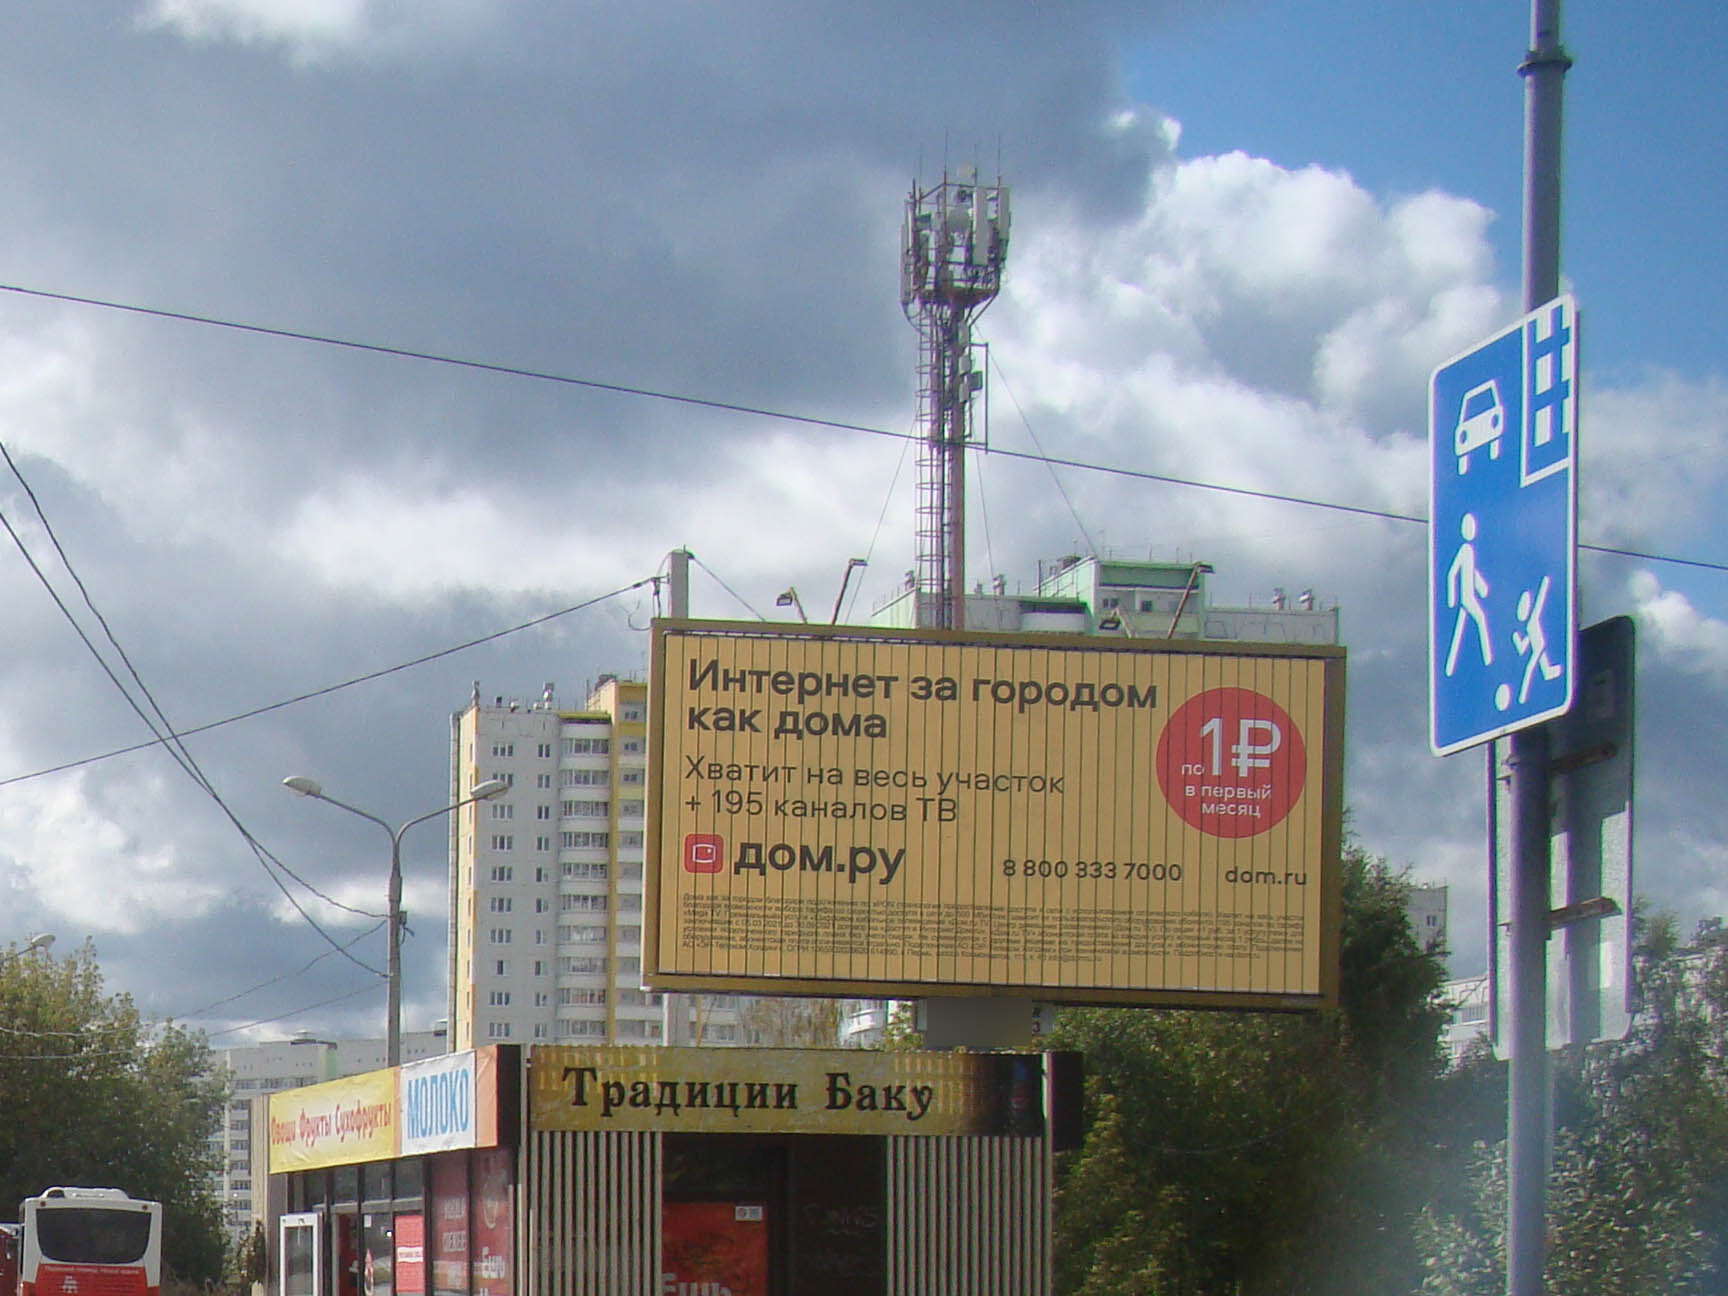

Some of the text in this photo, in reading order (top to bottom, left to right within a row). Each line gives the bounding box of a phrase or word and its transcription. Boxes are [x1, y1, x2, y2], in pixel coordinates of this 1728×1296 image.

[689, 658, 1158, 714] Интернет за городом
[688, 706, 888, 741] как дома
[685, 755, 1065, 796] Хватит на весь участок
[1181, 764, 1204, 776] по
[712, 789, 764, 816] 195
[774, 799, 907, 822] каналов
[916, 797, 957, 823] ТВ
[1185, 784, 1272, 801] в первый
[1202, 803, 1261, 819] месяц
[733, 842, 906, 885] дом.ру
[1003, 859, 1182, 881] 8 800 333 7000
[1225, 866, 1308, 886] dom.ru
[407, 1067, 469, 1140] МОЛОКО
[562, 1066, 934, 1121] Традиции Баку
[299, 1107, 331, 1148] Фрукты
[335, 1100, 392, 1143] Сухофрукты
